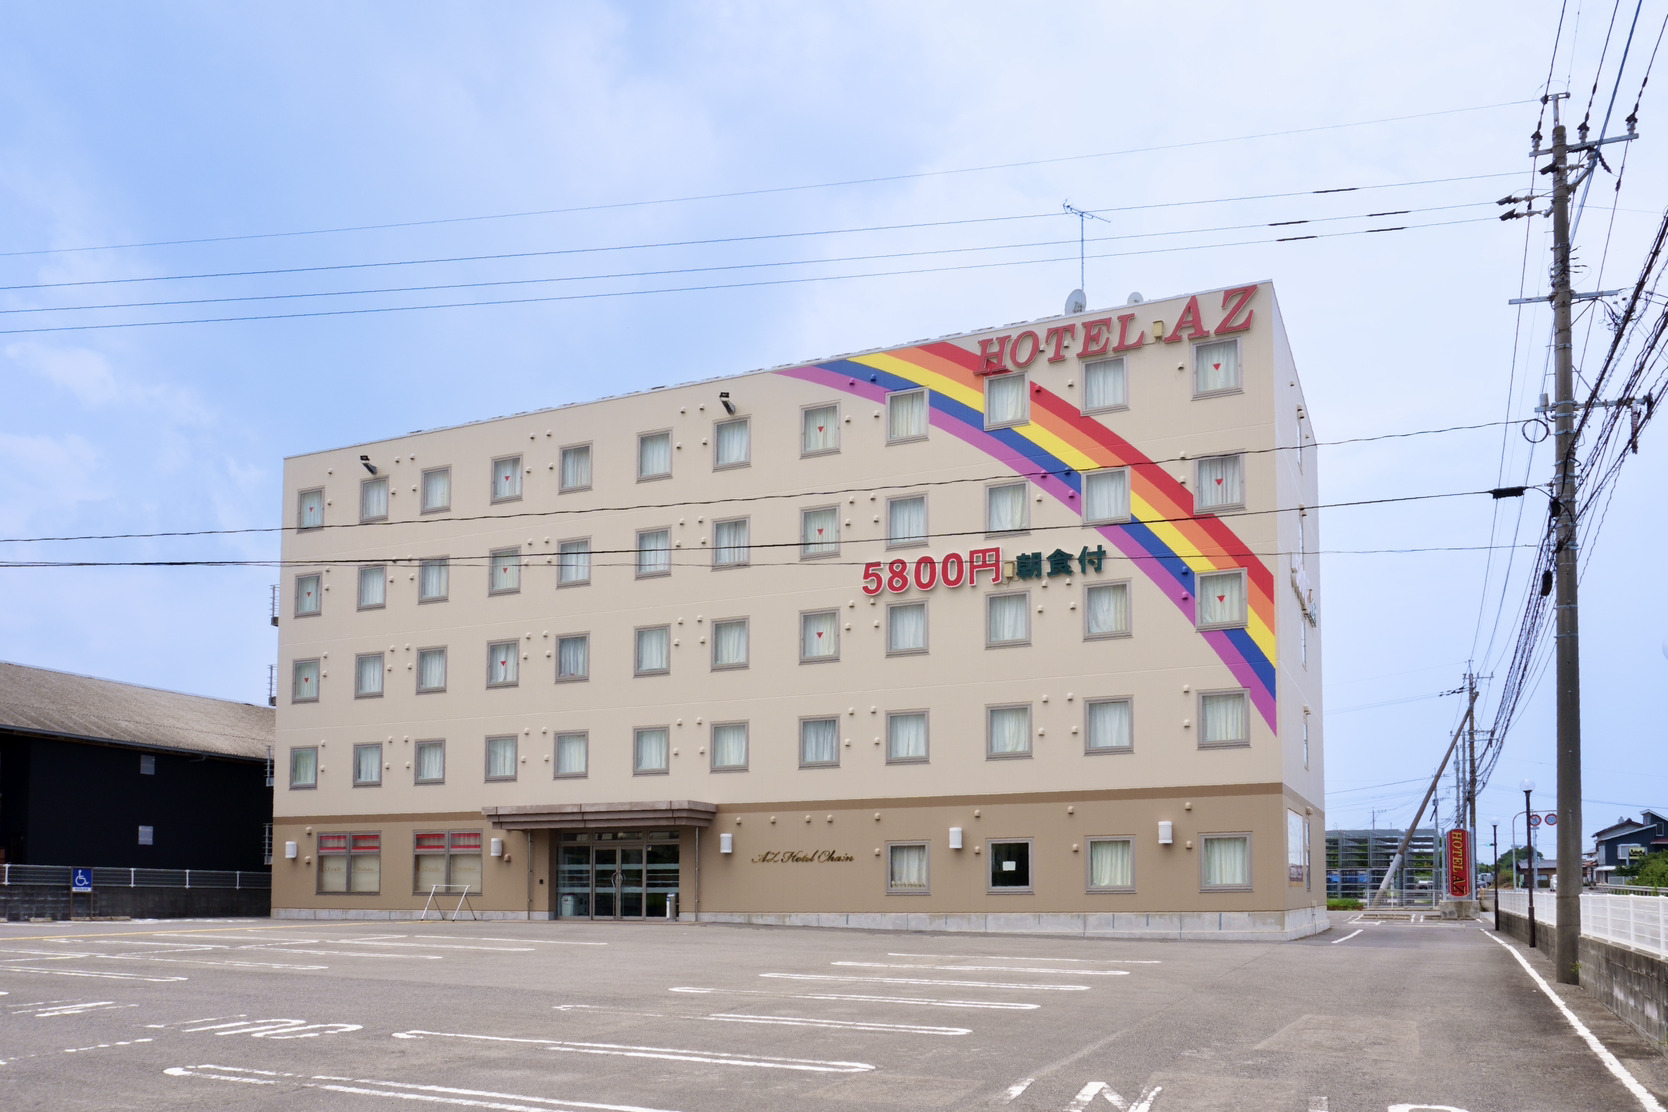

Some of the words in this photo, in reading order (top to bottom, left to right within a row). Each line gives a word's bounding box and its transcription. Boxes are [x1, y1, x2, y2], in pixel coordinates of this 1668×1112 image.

[973, 313, 1145, 376] HOTEL
[1164, 284, 1258, 343] AZ
[862, 547, 1002, 596] 5800円
[1016, 545, 1107, 580] 朝食付
[751, 850, 781, 864] AZ
[780, 850, 819, 864] Hotel
[817, 849, 855, 864] Chain
[1452, 831, 1464, 873] HOTEL
[1453, 875, 1466, 895] AZ
